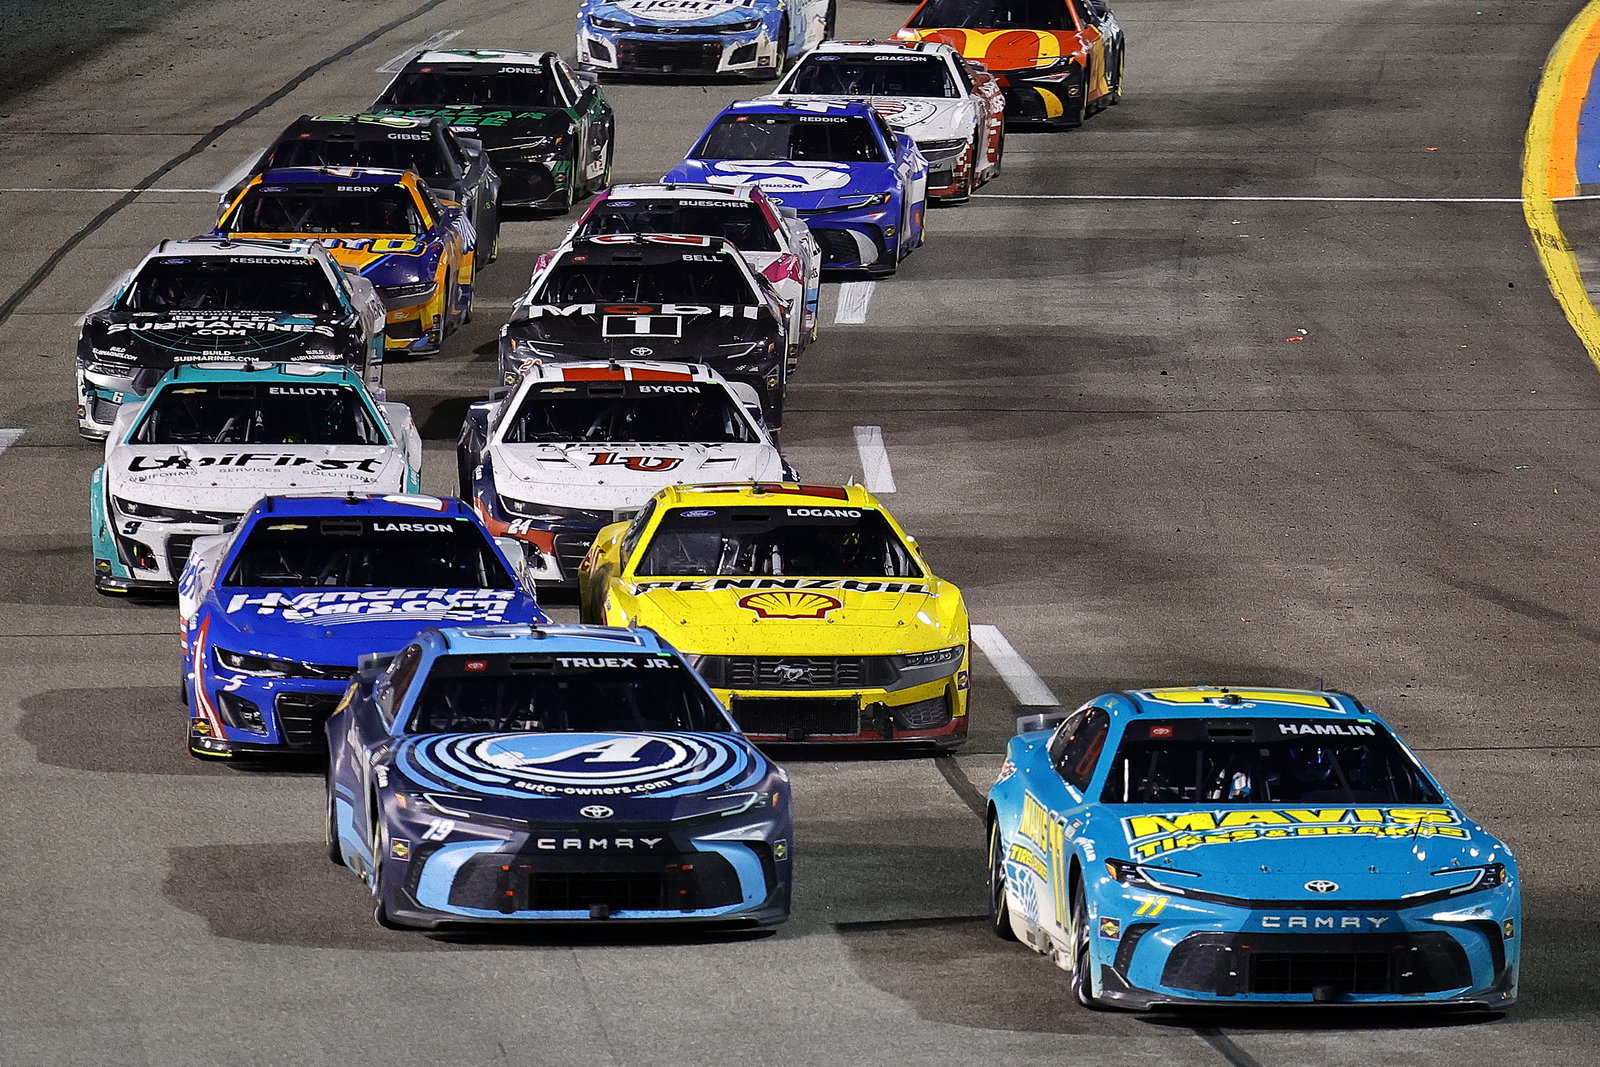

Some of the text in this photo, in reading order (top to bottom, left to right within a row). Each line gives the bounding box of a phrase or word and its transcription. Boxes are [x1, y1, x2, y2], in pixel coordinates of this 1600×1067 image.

[630, 0, 719, 11] LIGHT
[874, 54, 927, 62] GRAGSON
[498, 66, 542, 75] JONES
[387, 132, 431, 141] GIBBS
[337, 185, 379, 193] BERRY
[679, 199, 749, 208] BUESCHER
[229, 256, 313, 266] KESELOWSKI
[682, 254, 723, 263] BELL
[107, 319, 335, 338] SUBMARINES
[626, 316, 651, 335] 1
[192, 328, 247, 337] .COM
[173, 355, 260, 364] SUBMARINES.COM
[268, 386, 340, 396] ELLIOTT
[638, 385, 701, 394] BYRON
[112, 391, 124, 404] 6
[127, 453, 383, 474] UniFirst
[128, 470, 199, 483] UNIFORMS
[302, 469, 379, 483] SOLUTIONS
[787, 508, 862, 518] LOGANO
[122, 521, 142, 535] 9
[373, 522, 454, 533] LARSON
[507, 518, 533, 535] 24
[633, 578, 939, 597] PENNZOIL
[226, 588, 516, 614] Hendrick
[556, 657, 679, 669] TRUEX JR.
[219, 674, 248, 691] 5
[1277, 724, 1374, 736] HAMLIN
[514, 778, 673, 796] auto-owners.com
[420, 818, 456, 842] 19
[1127, 808, 1464, 840] MAVIS
[537, 837, 664, 850] CAMRY
[1136, 824, 1465, 858] TIRES & BRAKES
[1132, 895, 1168, 918] 11
[1261, 916, 1389, 929] CAMRY
